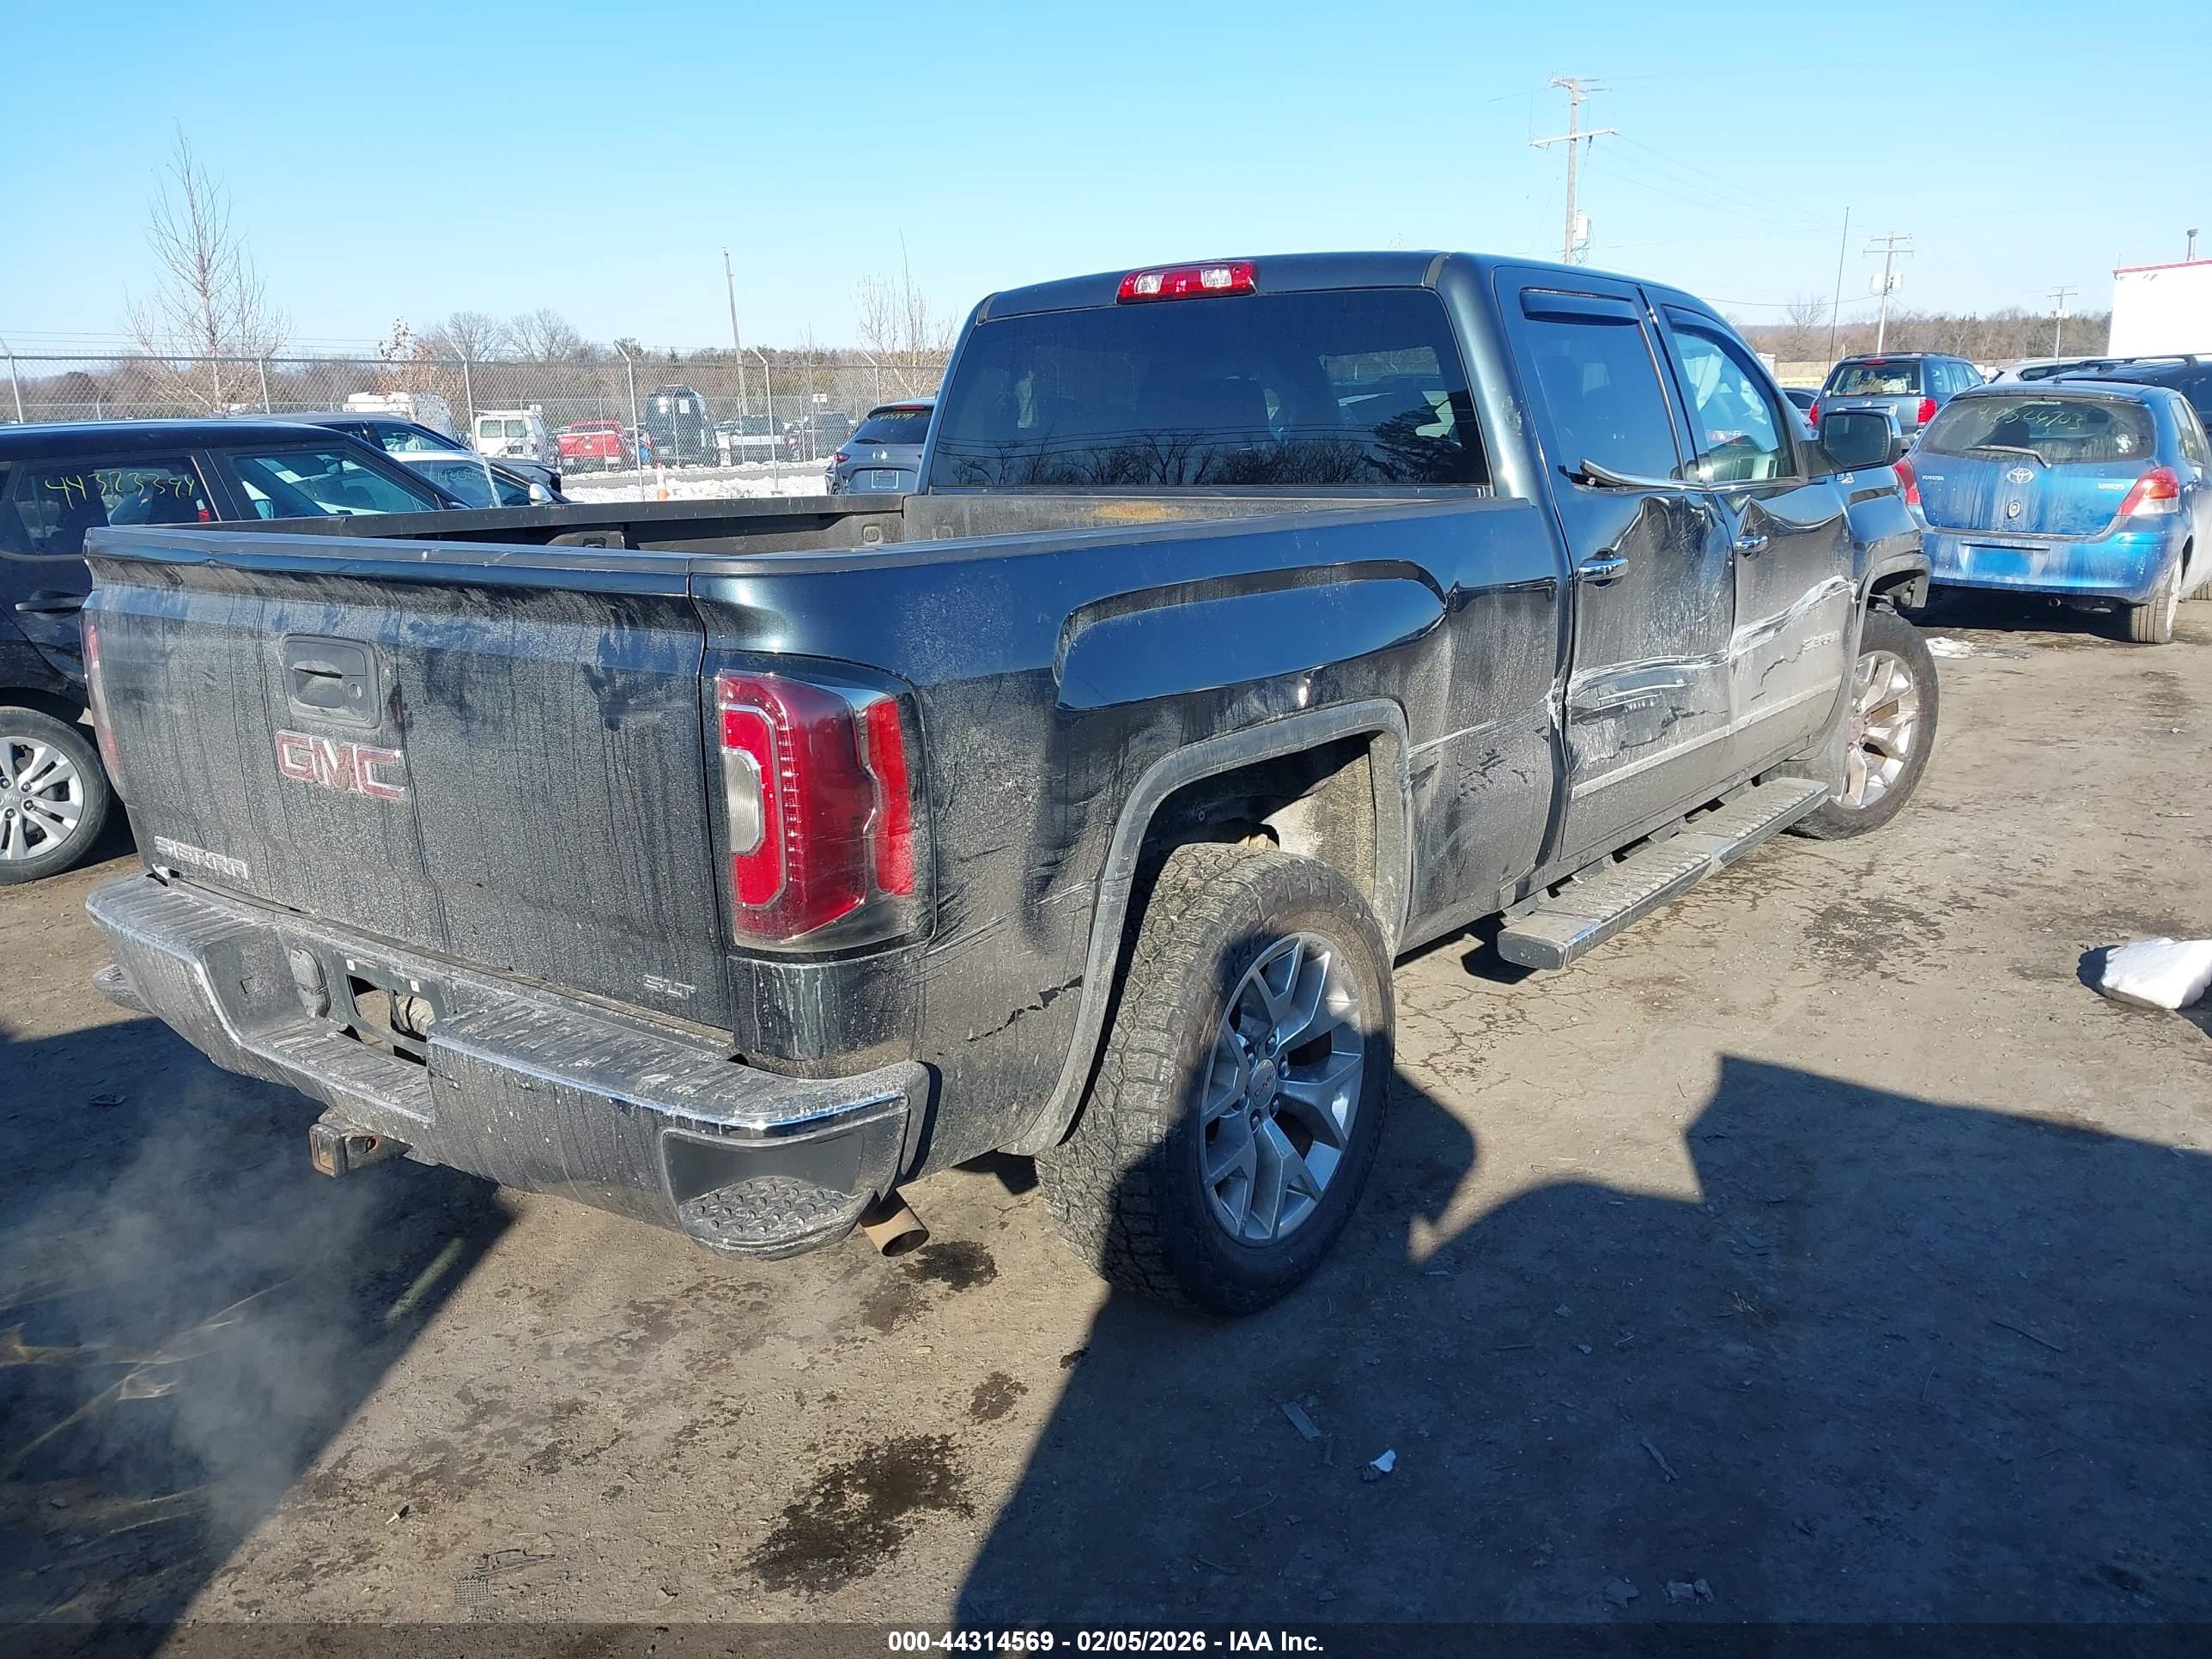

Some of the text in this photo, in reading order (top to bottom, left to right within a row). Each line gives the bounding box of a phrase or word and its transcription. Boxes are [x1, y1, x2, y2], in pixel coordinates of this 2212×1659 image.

[275, 729, 408, 804] GMC
[154, 836, 248, 880] SIERRA
[643, 974, 696, 1000] SLT
